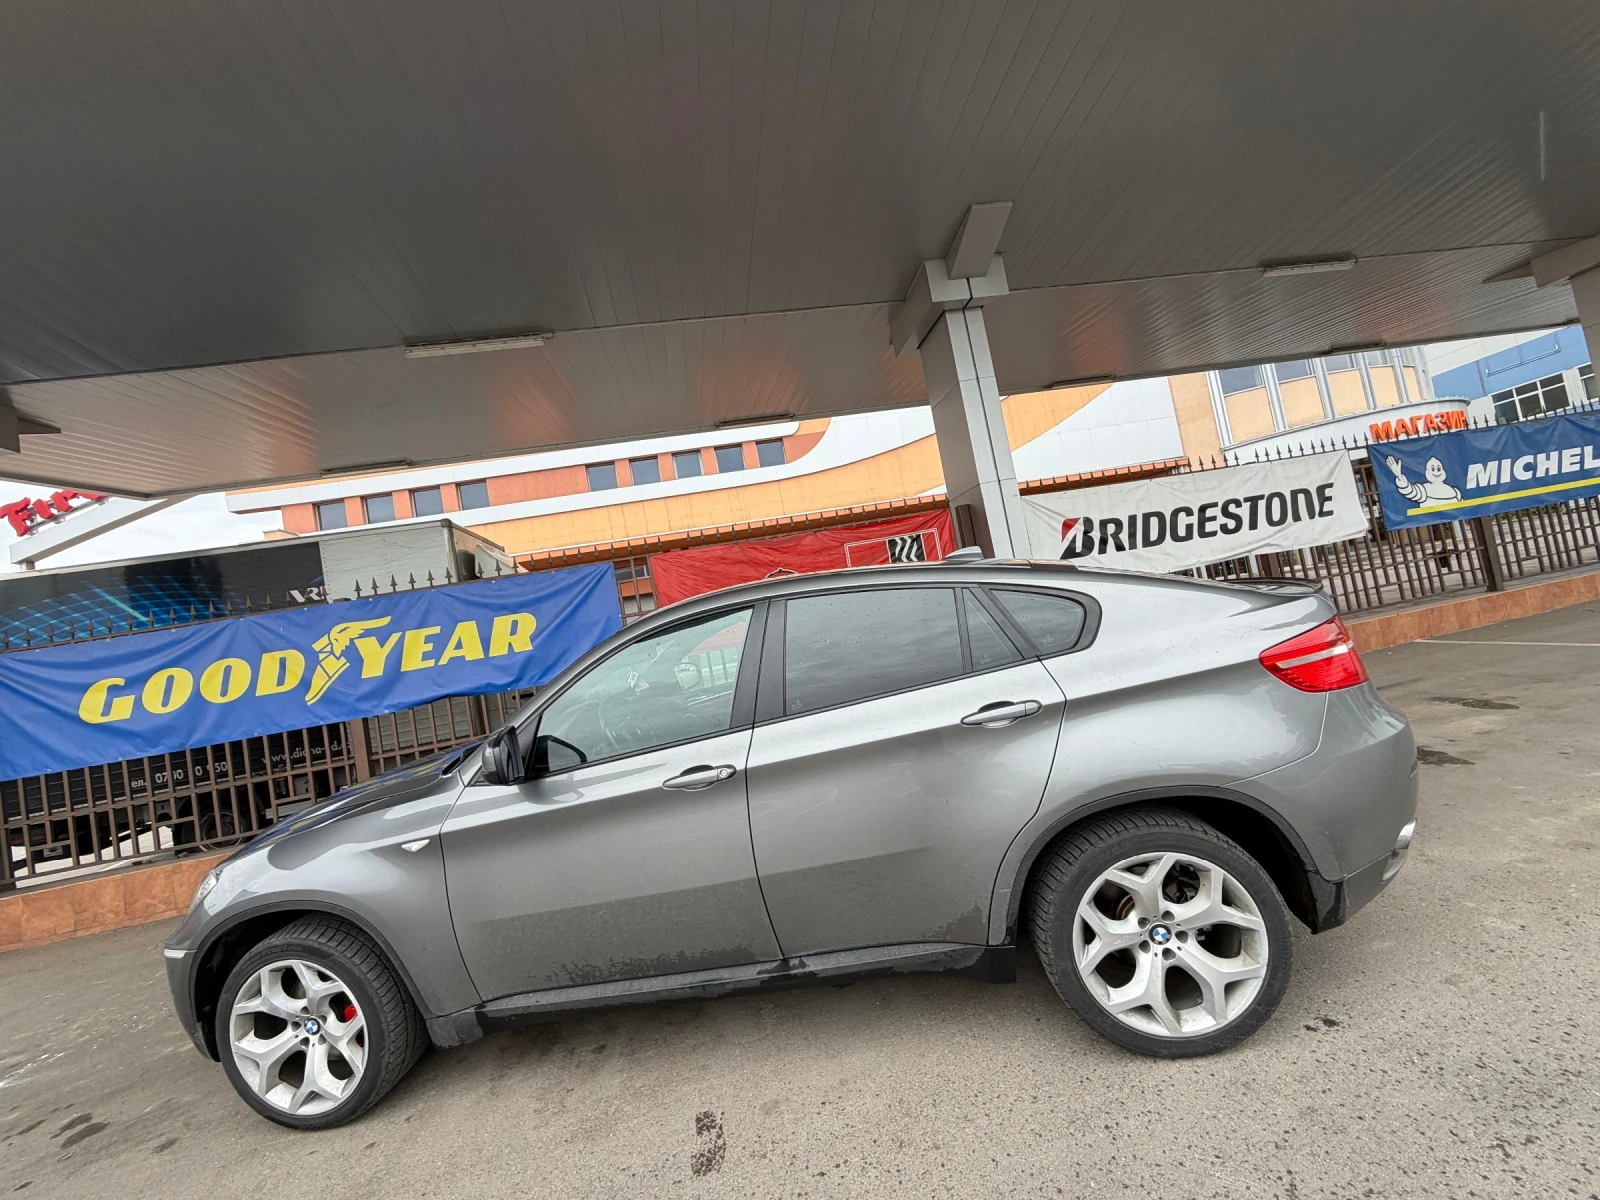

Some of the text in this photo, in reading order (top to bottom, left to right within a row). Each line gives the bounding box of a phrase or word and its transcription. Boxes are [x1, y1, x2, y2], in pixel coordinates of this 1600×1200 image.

[1370, 410, 1466, 442] МАГАЗИН
[1466, 446, 1600, 489] MICHEL
[1060, 482, 1334, 560] BRIDGESTONE
